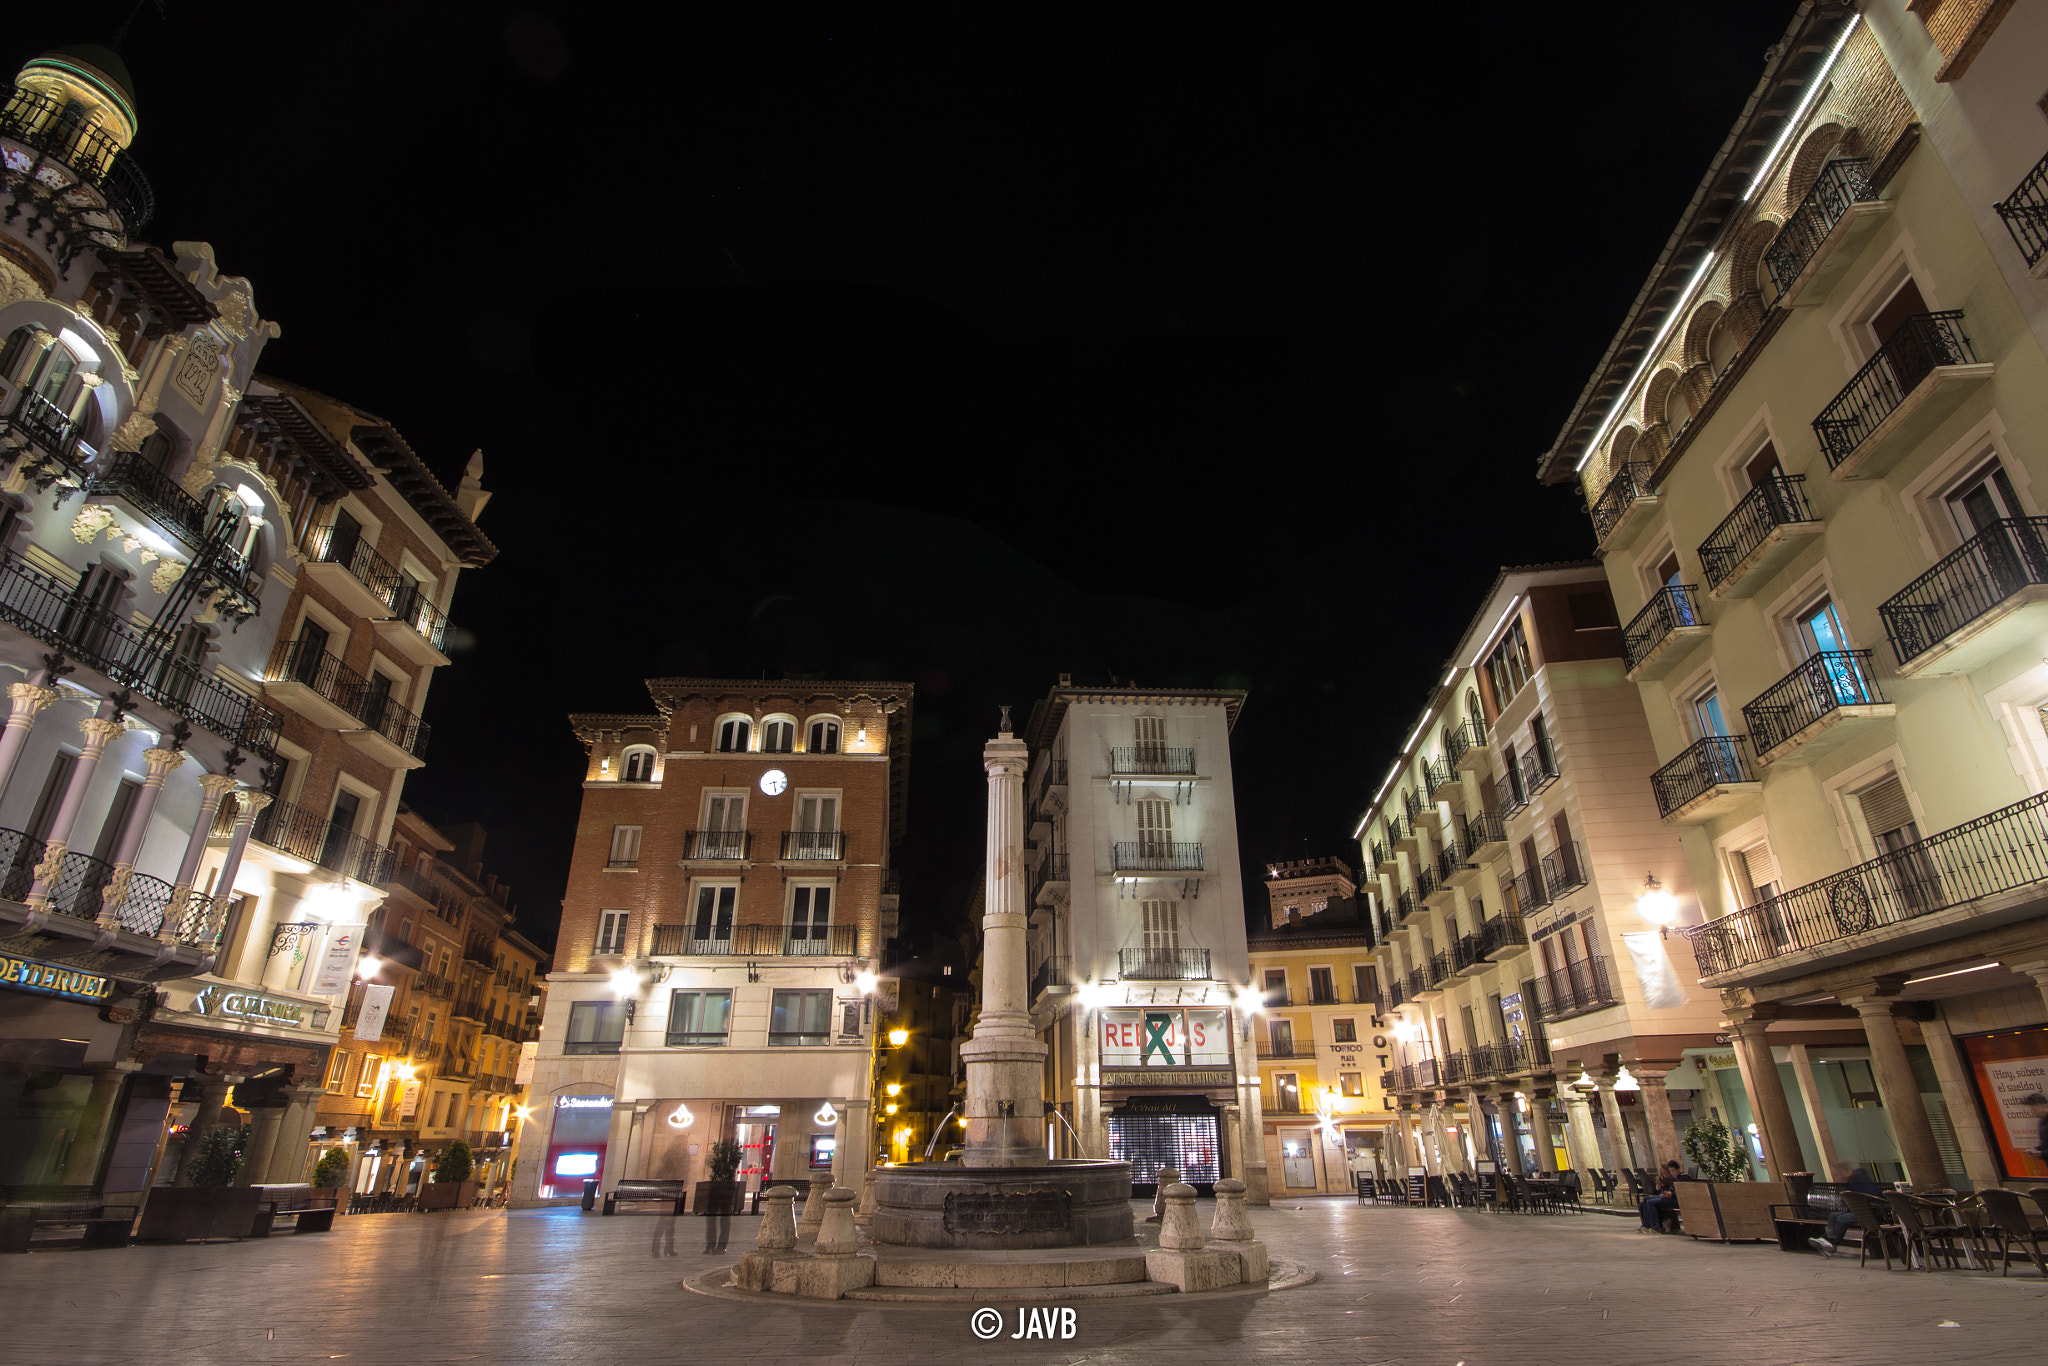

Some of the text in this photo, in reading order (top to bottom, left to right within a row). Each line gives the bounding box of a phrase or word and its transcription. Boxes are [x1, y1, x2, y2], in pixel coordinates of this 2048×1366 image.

[184, 362, 208, 393] 1912
[27, 963, 109, 998] TERUEL
[1105, 1022, 1207, 1048] REBJS
[1330, 1044, 1364, 1053] TORICO
[1370, 1014, 1395, 1111] HOTEL
[1997, 1081, 2043, 1093] el sueldo y
